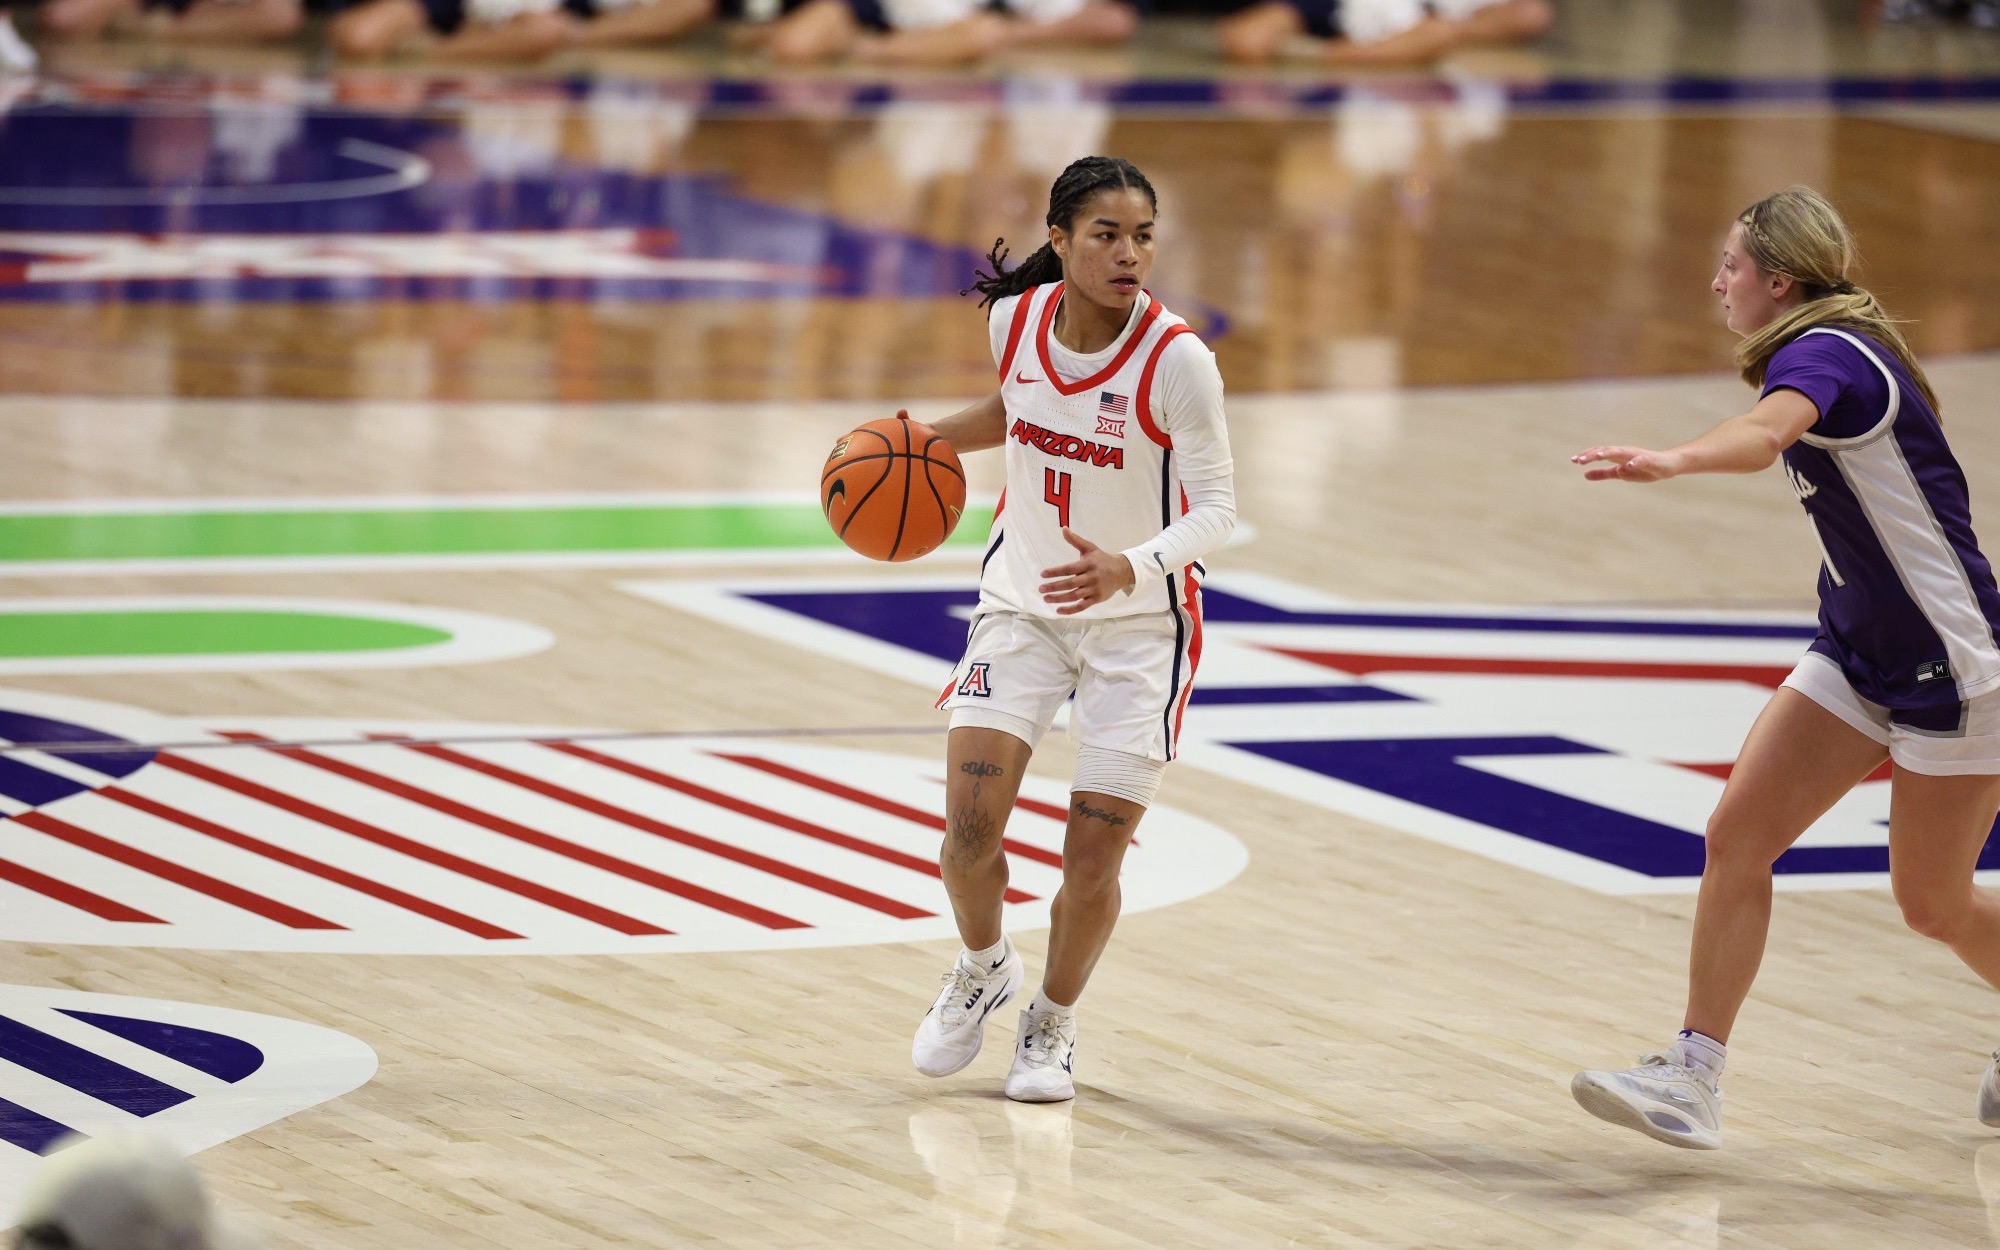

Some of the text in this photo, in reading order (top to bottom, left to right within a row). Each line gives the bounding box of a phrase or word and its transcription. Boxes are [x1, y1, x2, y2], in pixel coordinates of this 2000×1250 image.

[1010, 417, 1124, 470] ARIZONA
[1044, 466, 1072, 528] 4
[957, 662, 994, 698] A
